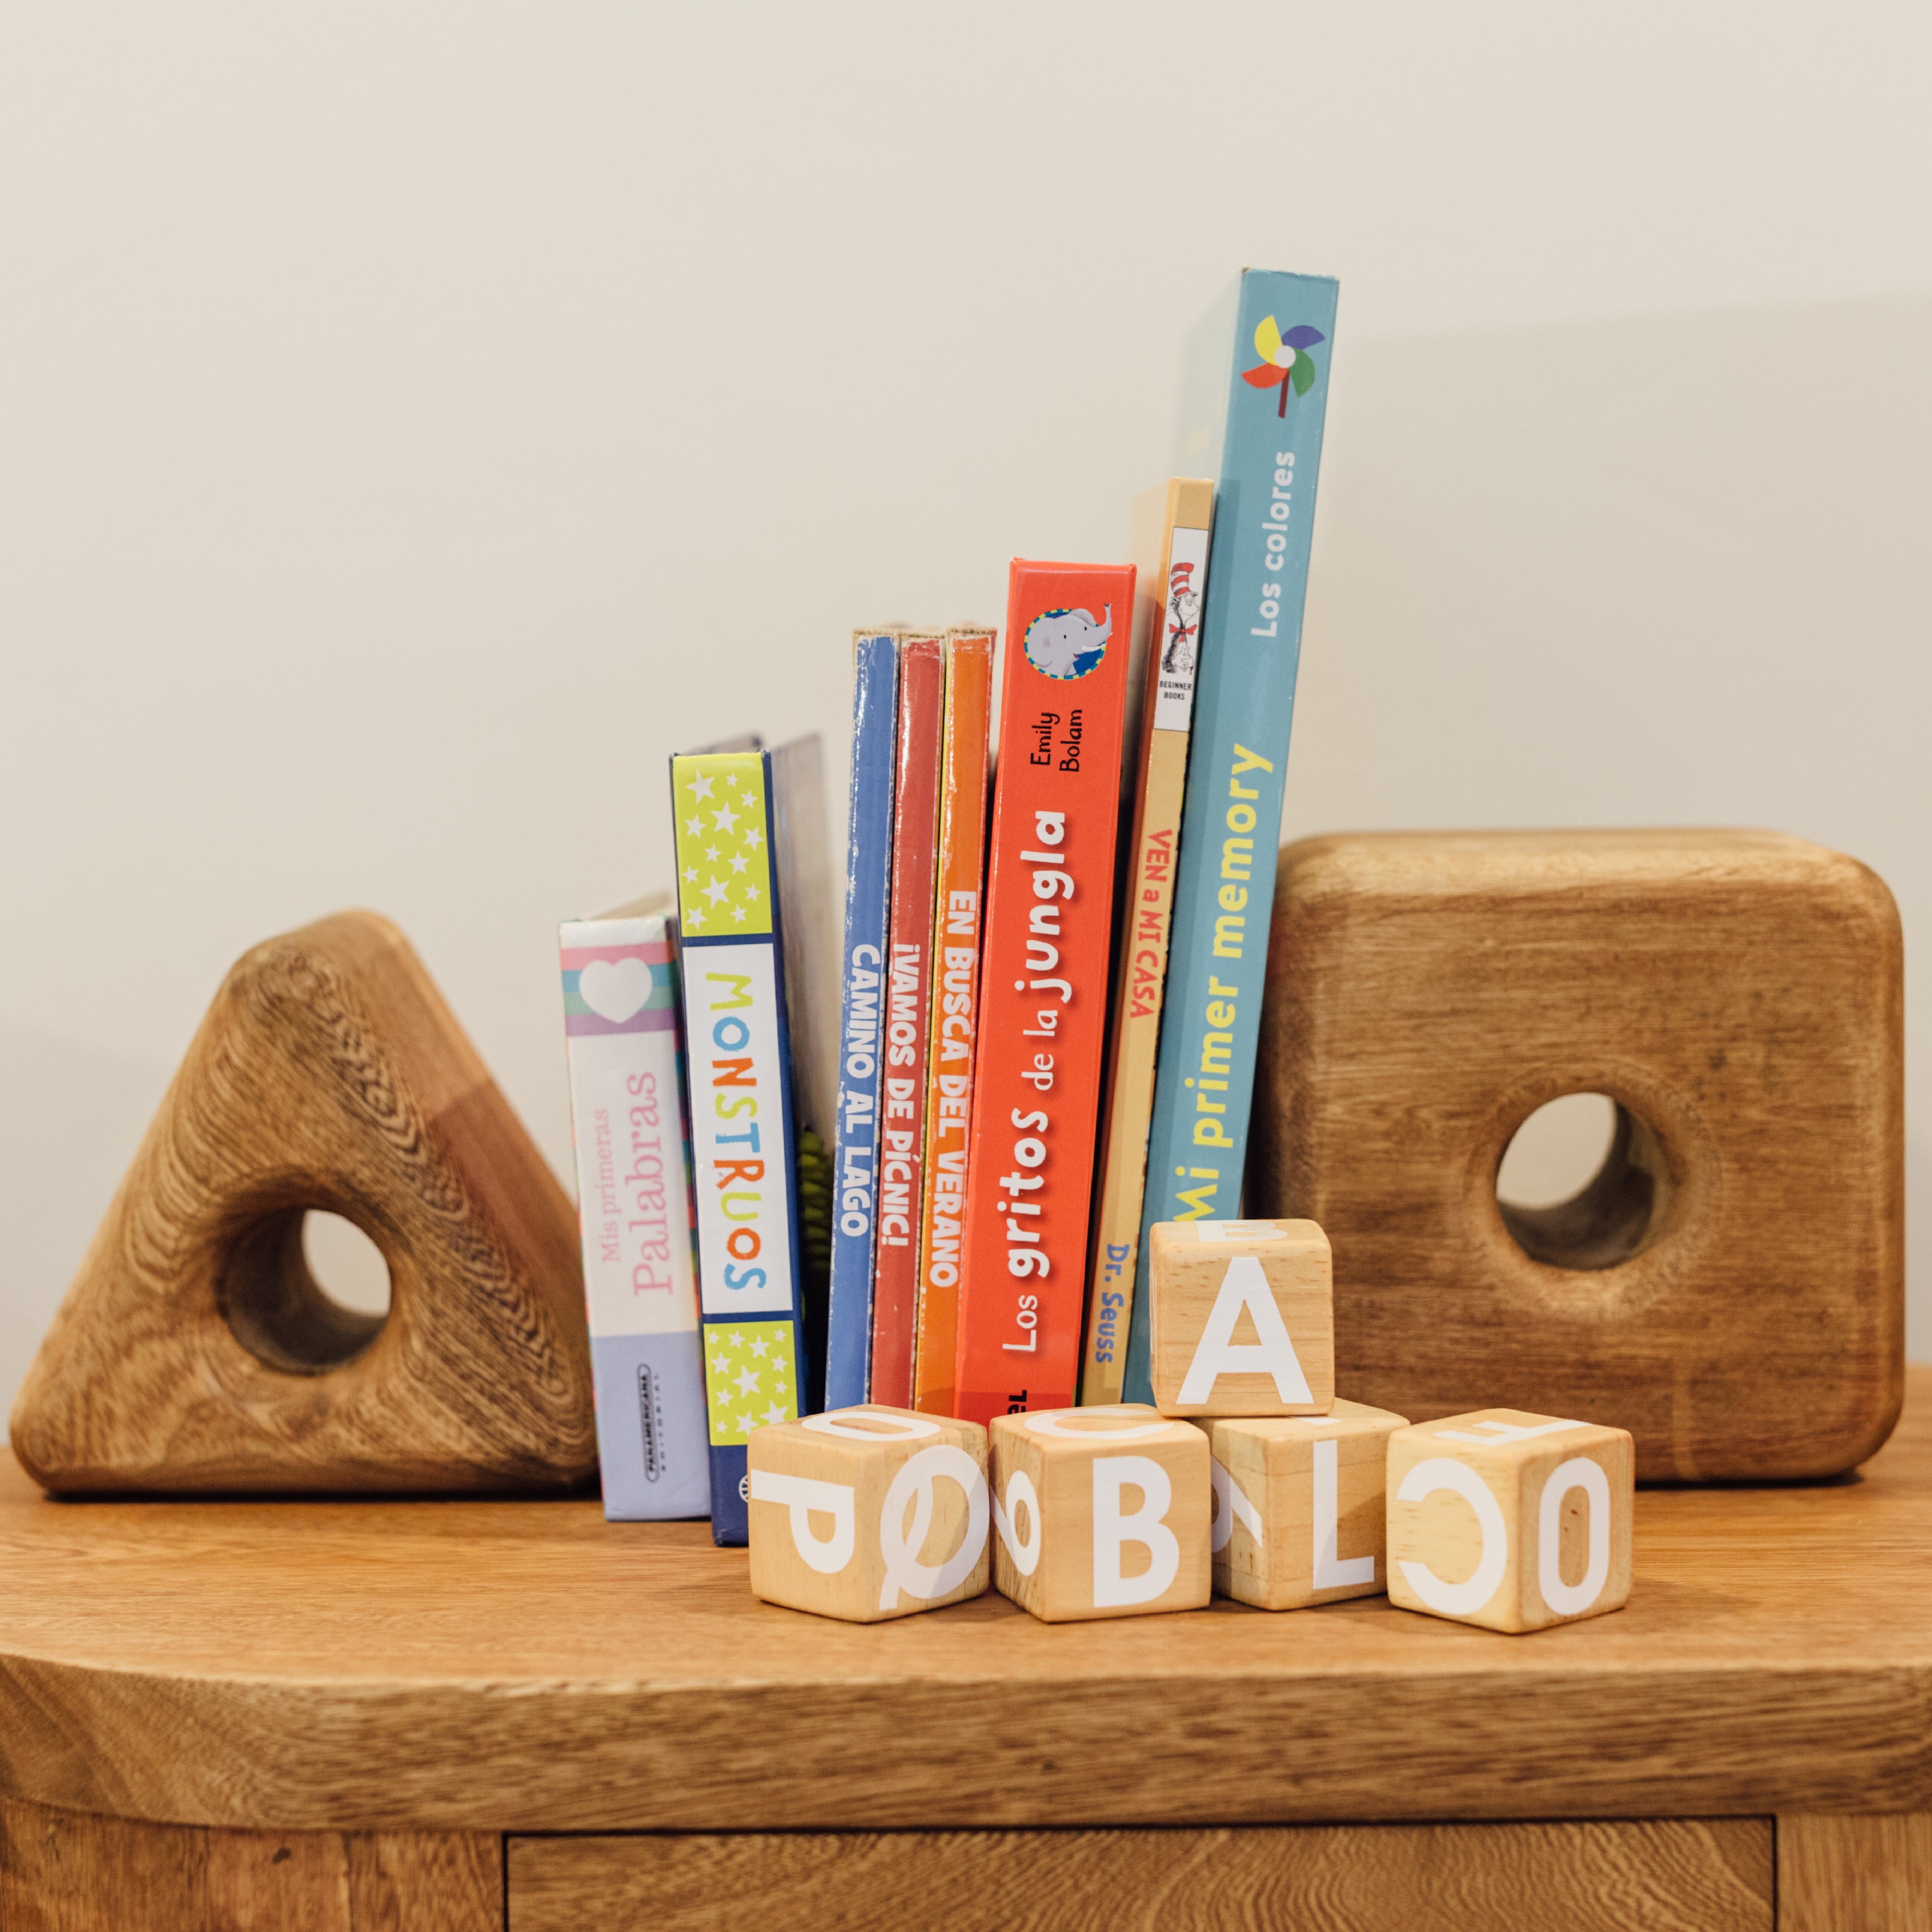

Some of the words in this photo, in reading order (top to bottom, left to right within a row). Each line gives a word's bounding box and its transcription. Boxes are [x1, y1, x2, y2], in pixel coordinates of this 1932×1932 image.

[1262, 452, 1295, 571] colores
[1251, 584, 1281, 637] Los
[1159, 680, 1192, 691] BEGINNER
[1164, 692, 1185, 700] BOOKS
[1031, 712, 1060, 765] Emily
[1059, 709, 1082, 772] Bolam
[1145, 829, 1173, 883] VEN
[1212, 743, 1273, 959] memory
[947, 891, 977, 934] EN
[1138, 910, 1164, 943] MI
[1142, 890, 1159, 902] a
[846, 944, 880, 1079] CAMINO
[888, 944, 920, 1067] ¡VAMOS
[941, 947, 974, 1061] BUSCA
[1130, 950, 1158, 1018] CASA
[1023, 1010, 1058, 1037] la
[1021, 1053, 1054, 1090] de
[1185, 976, 1238, 1148] primer
[705, 972, 766, 1290] MONSTRUOS
[845, 1090, 874, 1133] AL
[887, 1078, 915, 1119] DE
[938, 1074, 967, 1137] DEL
[594, 1108, 621, 1216] primeras
[625, 1072, 673, 1296] Palabras
[841, 1147, 871, 1236] LAGO
[881, 1131, 920, 1246] PÍCNIC!
[997, 1108, 1050, 1278] gritos
[1173, 1166, 1219, 1222] Mi
[601, 1219, 621, 1262] Mis
[929, 1150, 965, 1287] VERANO
[1195, 1221, 1288, 1241] B
[1105, 1244, 1130, 1283] Dr.
[1002, 1295, 1038, 1352] Los
[1096, 1292, 1124, 1364] Seuss
[1176, 1257, 1314, 1405] A
[1024, 1408, 1173, 1439] C
[751, 1469, 855, 1574] P
[879, 1445, 989, 1611] Q
[1093, 1456, 1179, 1608] B
[1313, 1440, 1374, 1589] L
[1396, 1458, 1508, 1615] C
